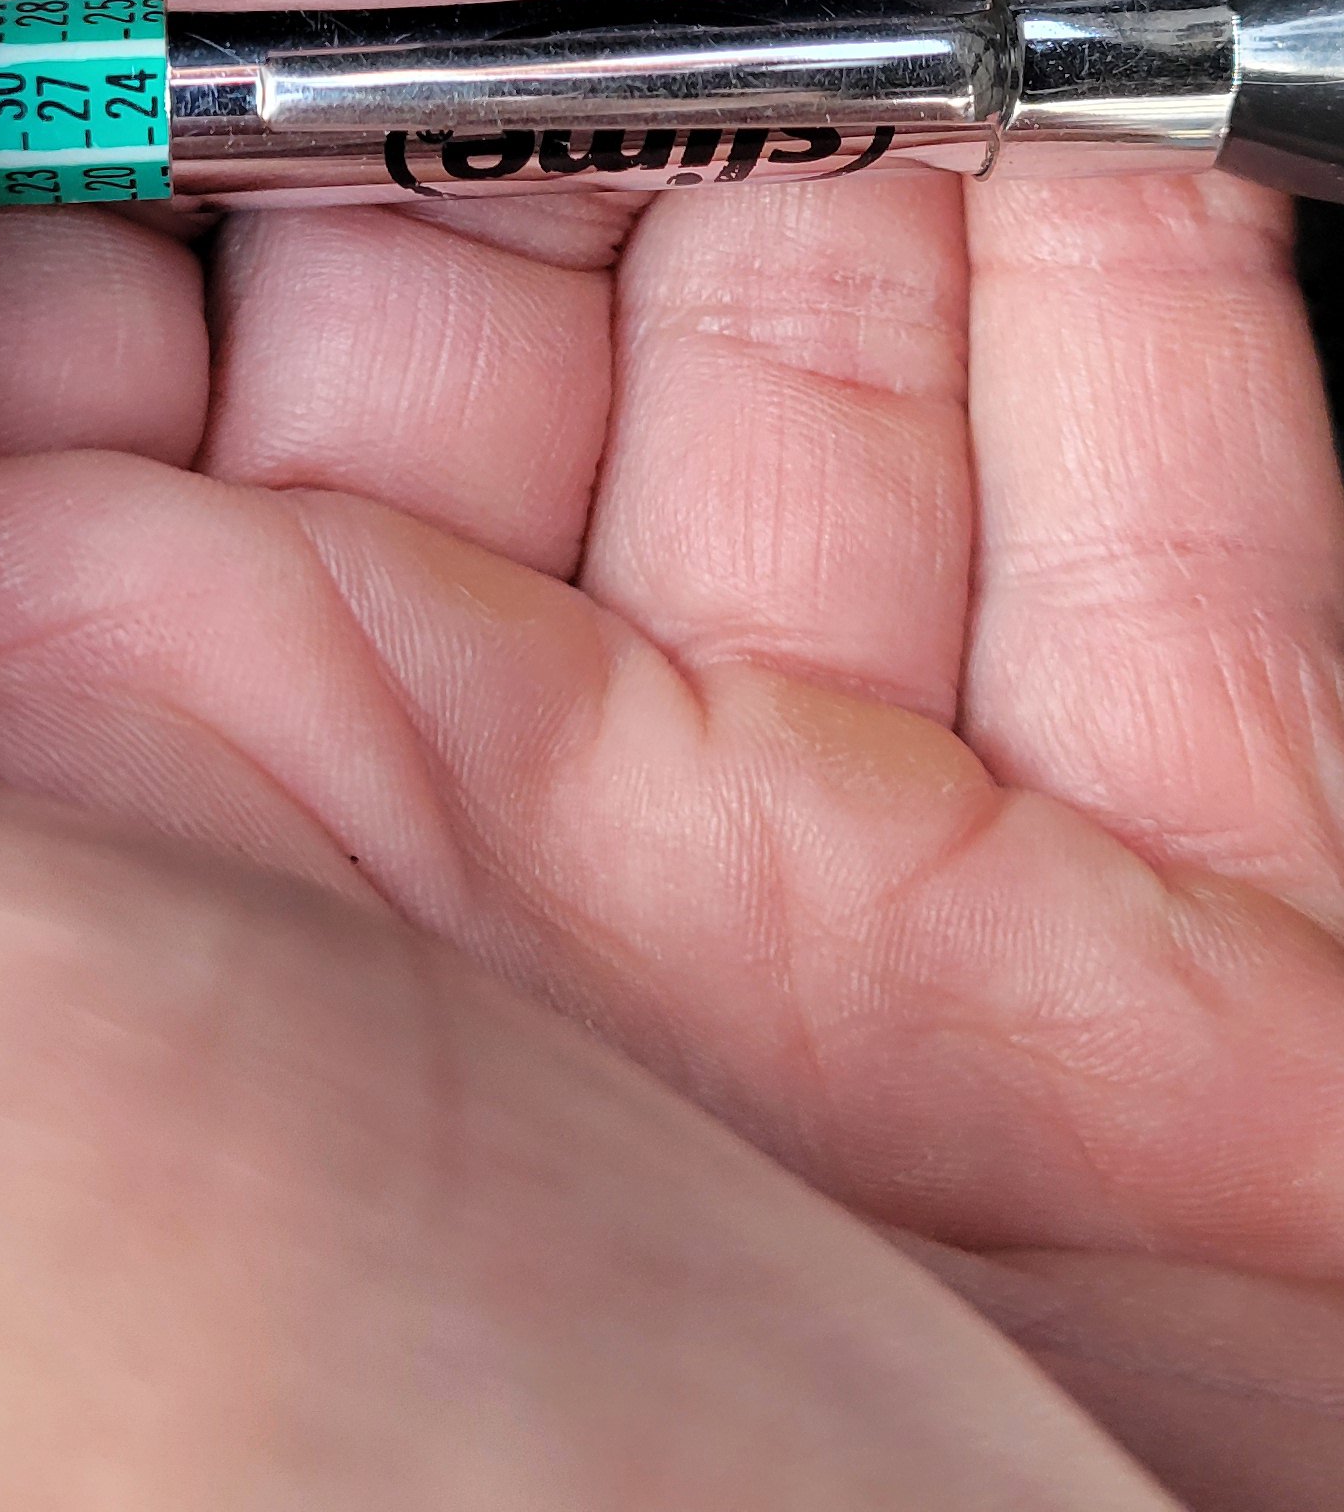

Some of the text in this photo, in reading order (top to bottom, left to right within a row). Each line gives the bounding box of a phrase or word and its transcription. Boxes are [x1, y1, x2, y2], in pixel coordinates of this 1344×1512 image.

[16, 0, 69, 27] 28
[37, 76, 90, 122] 27
[106, 69, 158, 119] 24
[6, 169, 59, 194] 23
[83, 166, 136, 191] 20
